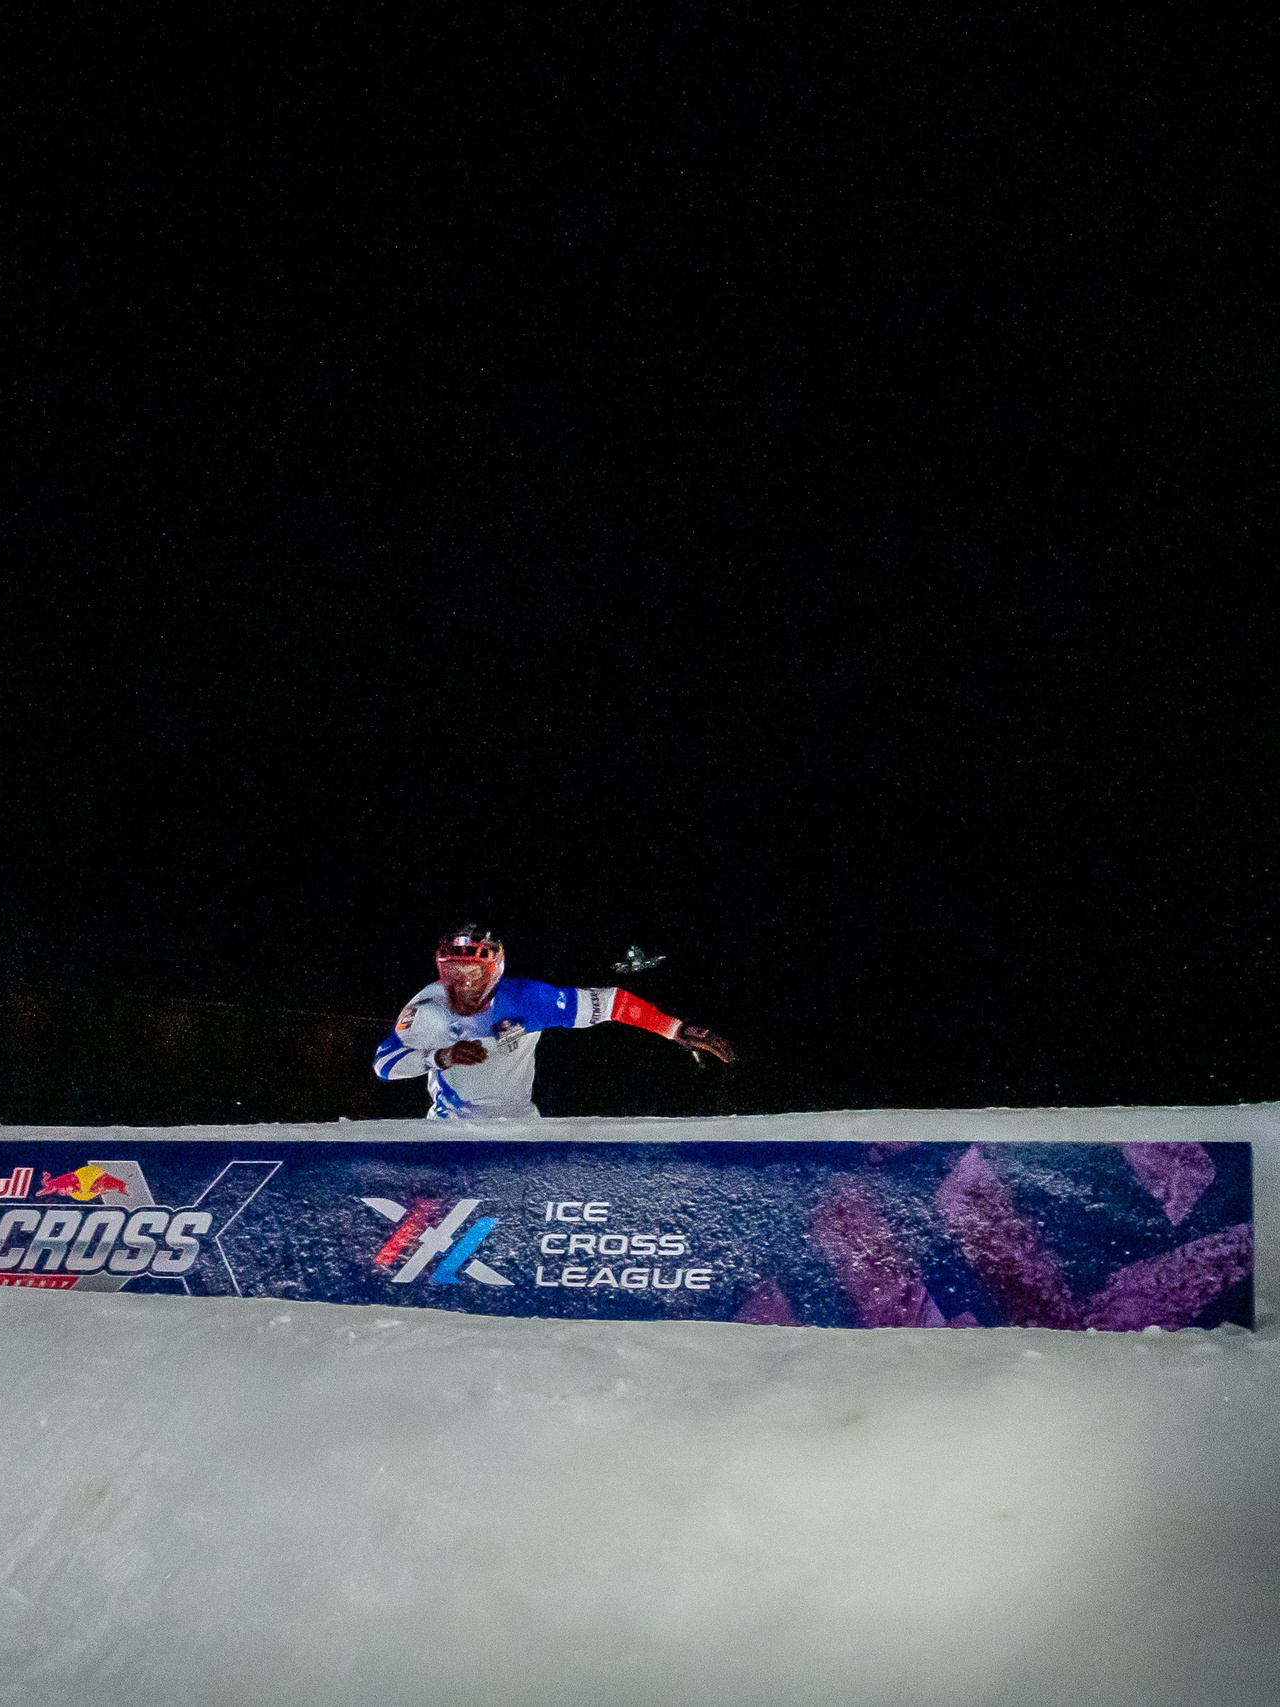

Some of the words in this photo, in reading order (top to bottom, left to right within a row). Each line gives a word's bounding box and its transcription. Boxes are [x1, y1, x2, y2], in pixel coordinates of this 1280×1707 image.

[544, 1201, 610, 1222] ICE
[540, 1234, 687, 1256] CROSS
[535, 1267, 712, 1290] LEAGUE
